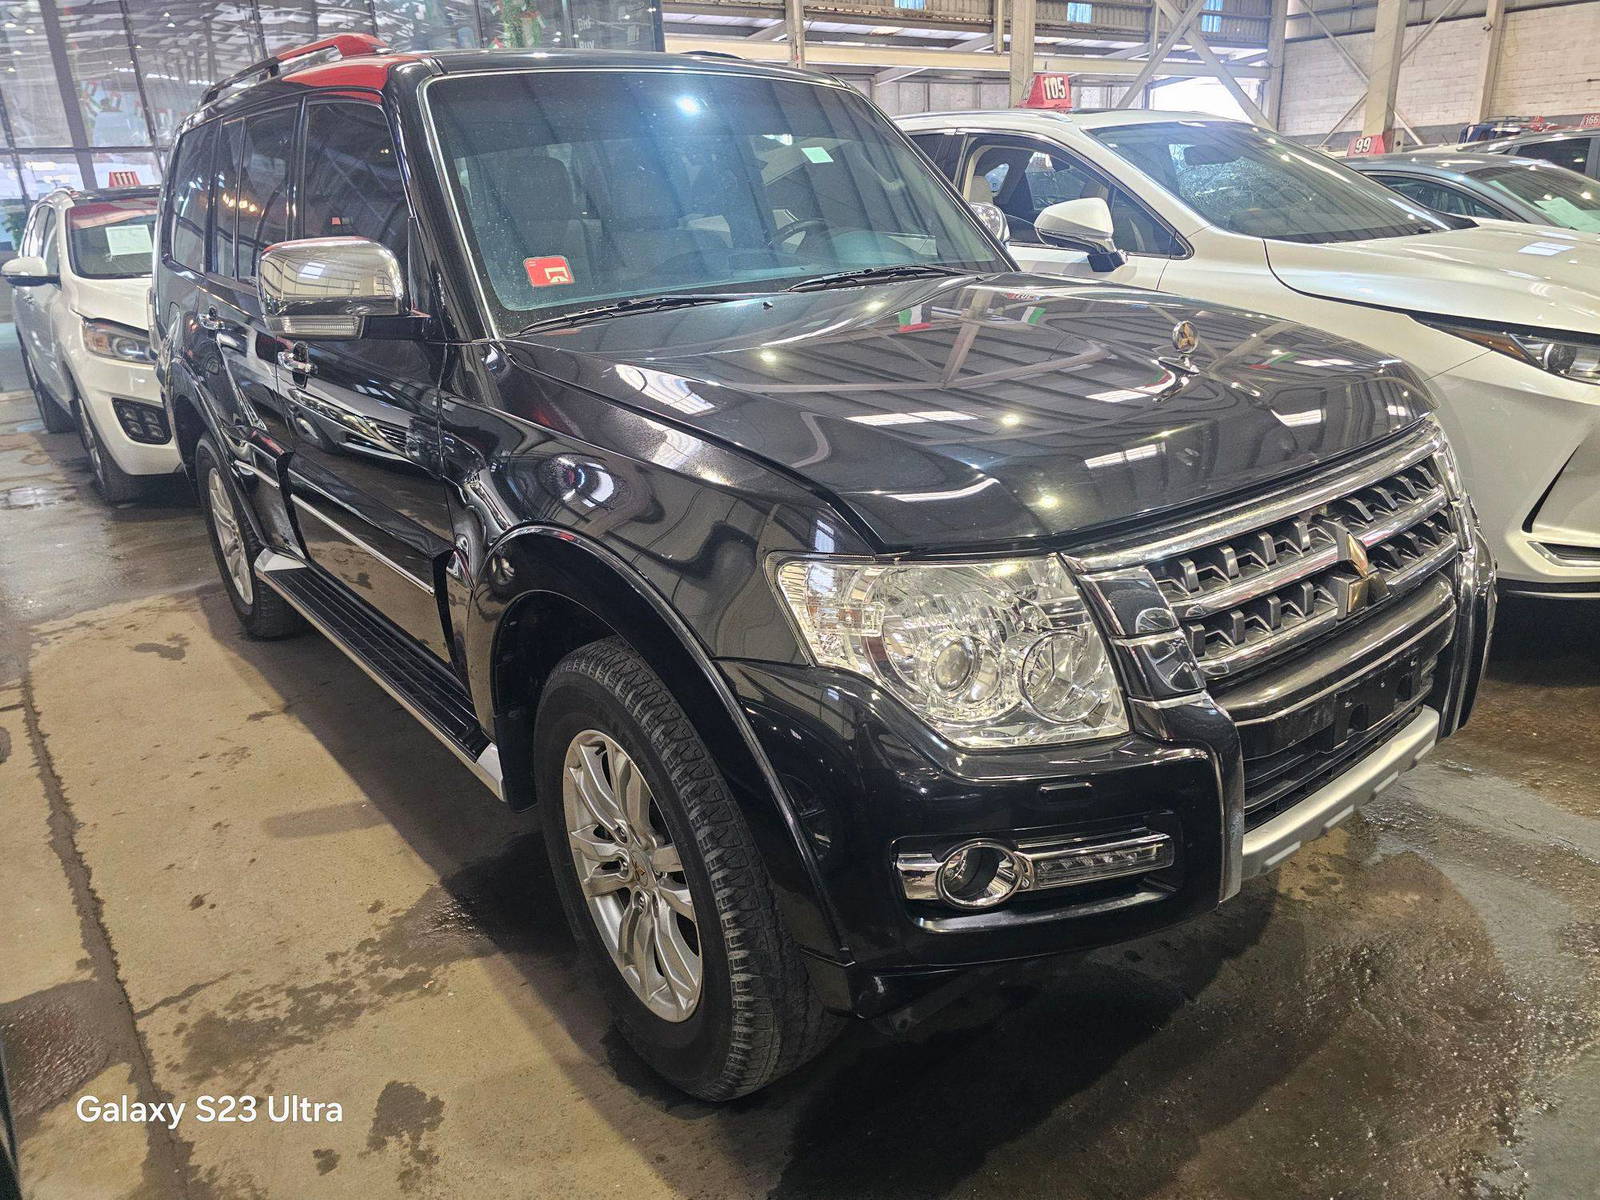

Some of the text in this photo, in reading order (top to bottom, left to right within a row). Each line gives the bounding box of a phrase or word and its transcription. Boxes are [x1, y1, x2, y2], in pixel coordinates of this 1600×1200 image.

[1043, 76, 1066, 100] 105
[1354, 136, 1371, 153] 99
[115, 172, 136, 185] 111
